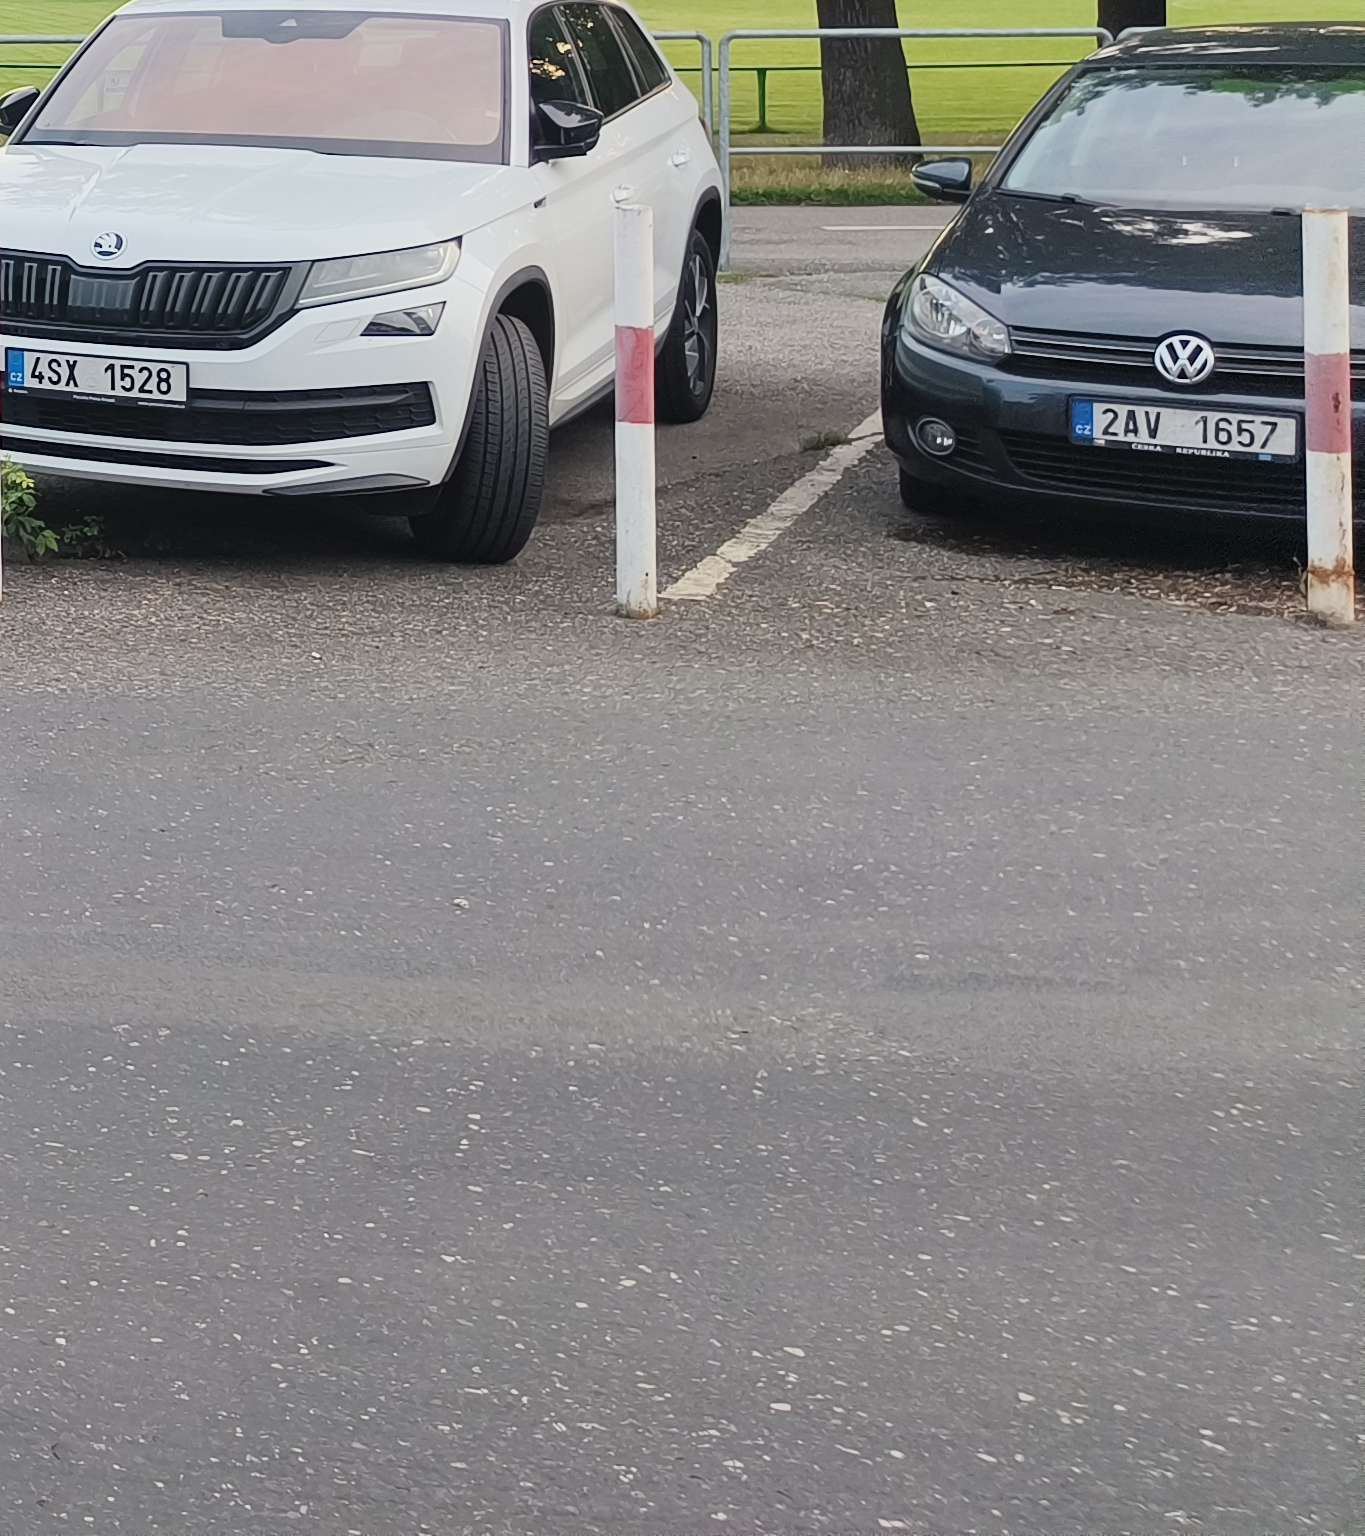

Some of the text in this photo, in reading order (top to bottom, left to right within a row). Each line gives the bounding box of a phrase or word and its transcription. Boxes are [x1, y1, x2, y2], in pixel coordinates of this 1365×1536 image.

[10, 372, 23, 382] CZ
[30, 356, 172, 396] 4SX 1528
[1075, 424, 1092, 435] CZ
[1101, 408, 1278, 450] 2AV 1657
